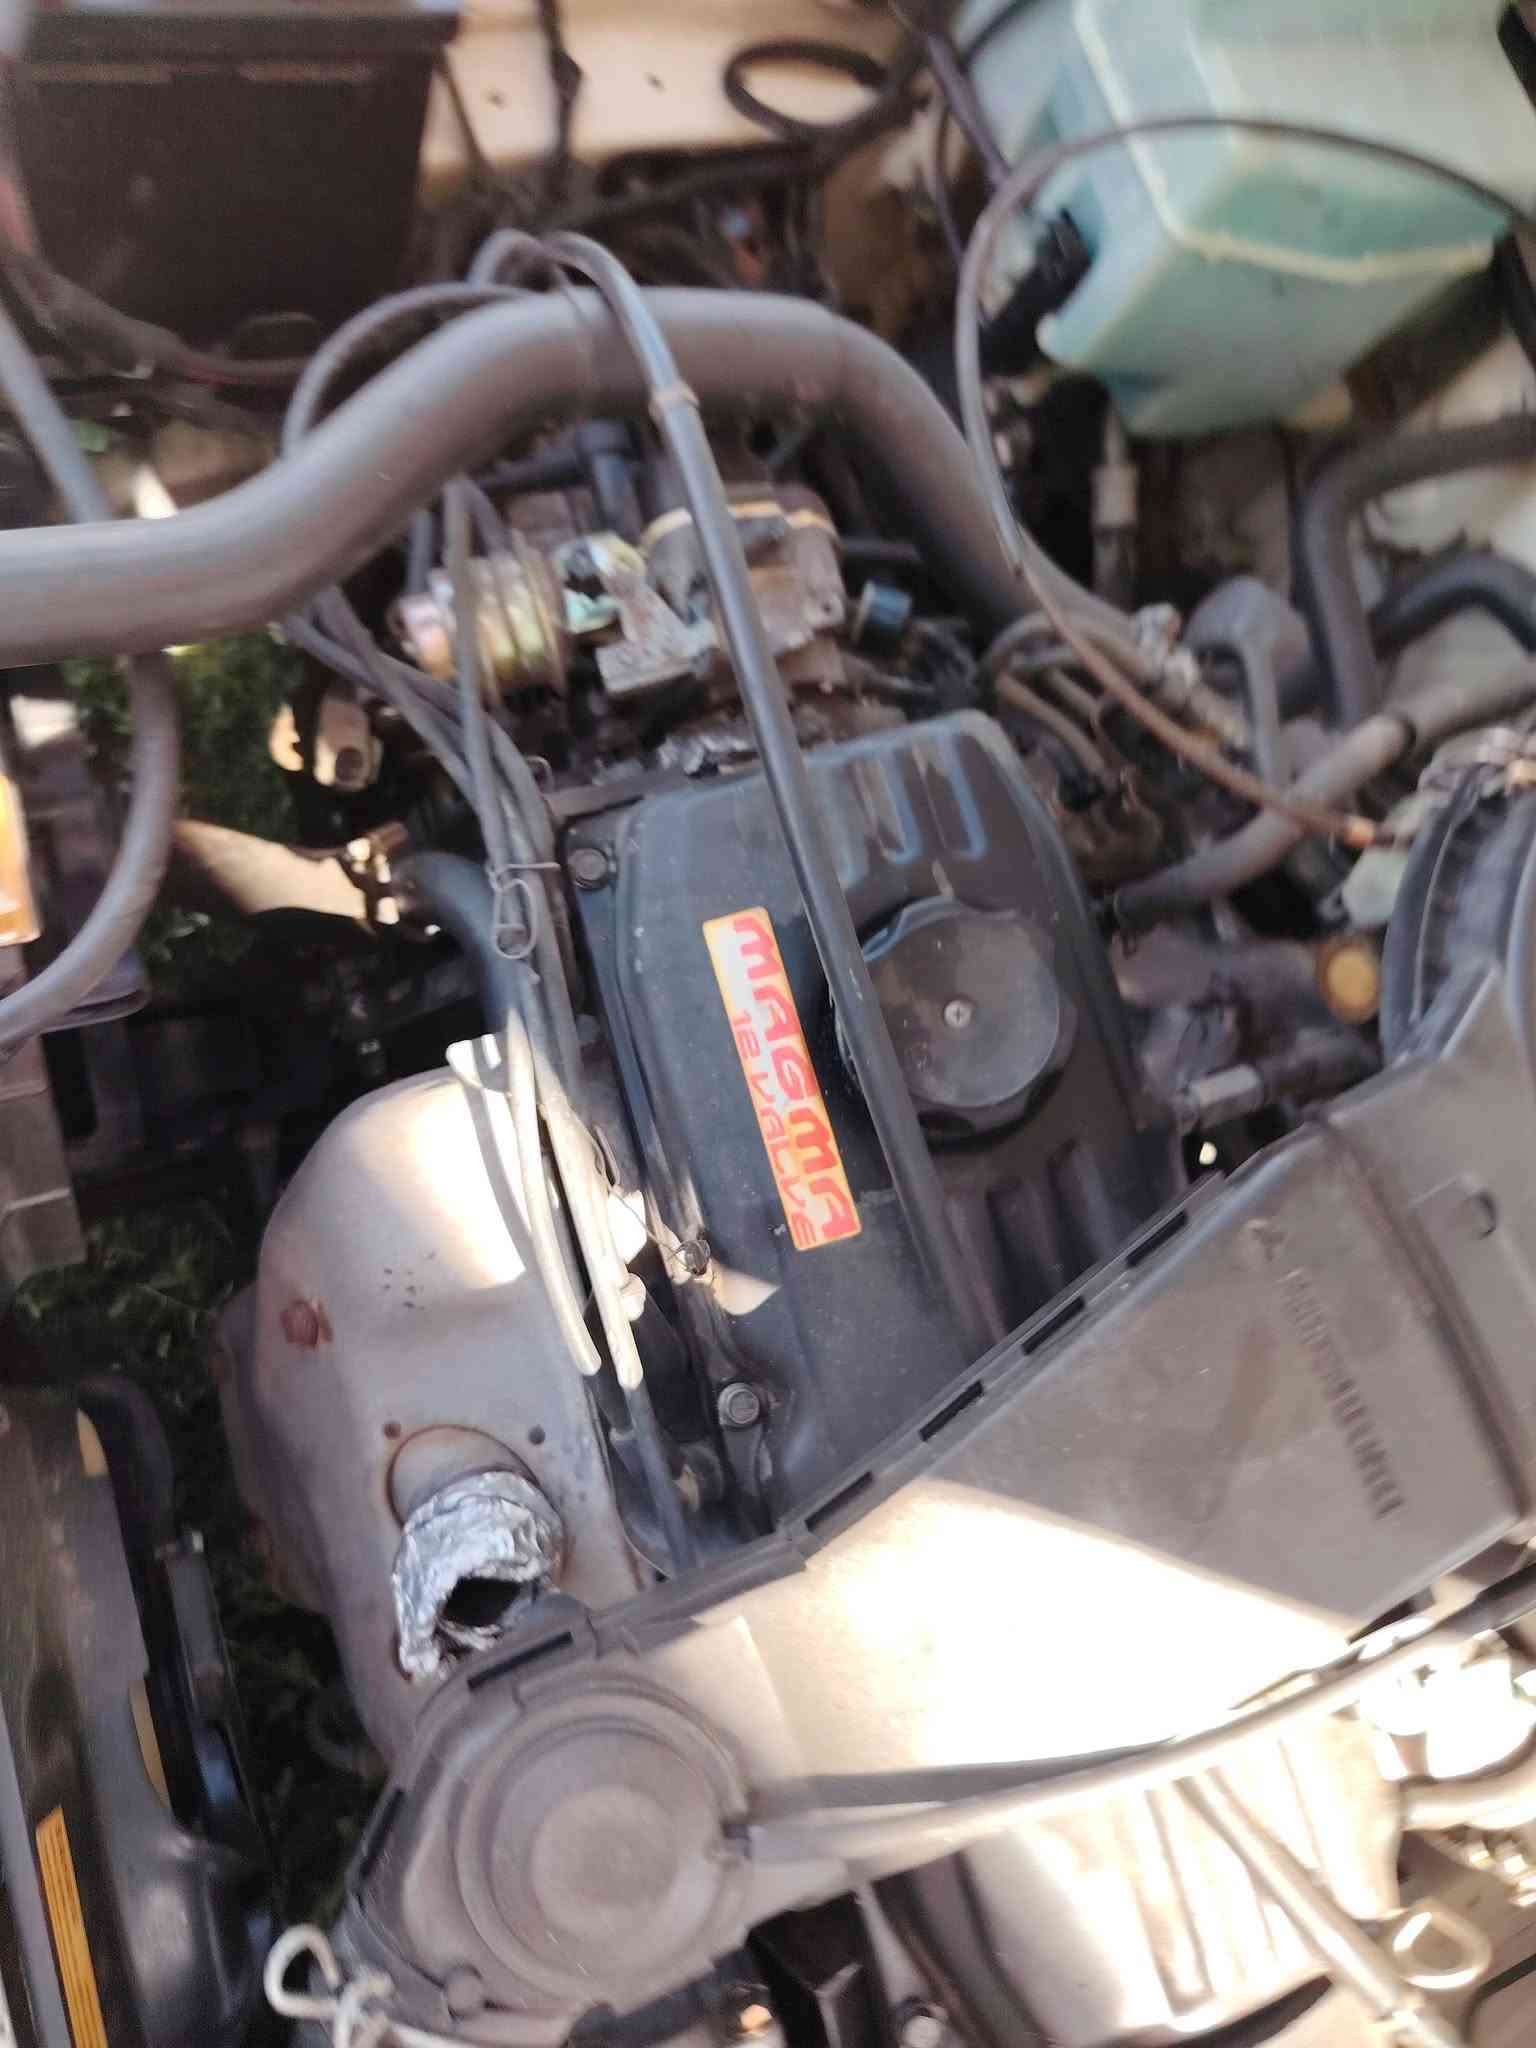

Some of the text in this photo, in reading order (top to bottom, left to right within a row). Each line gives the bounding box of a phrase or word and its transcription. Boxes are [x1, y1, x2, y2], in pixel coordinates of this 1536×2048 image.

[732, 1010, 816, 1248] 12 VALVE
[733, 917, 857, 1237] MAGMA
